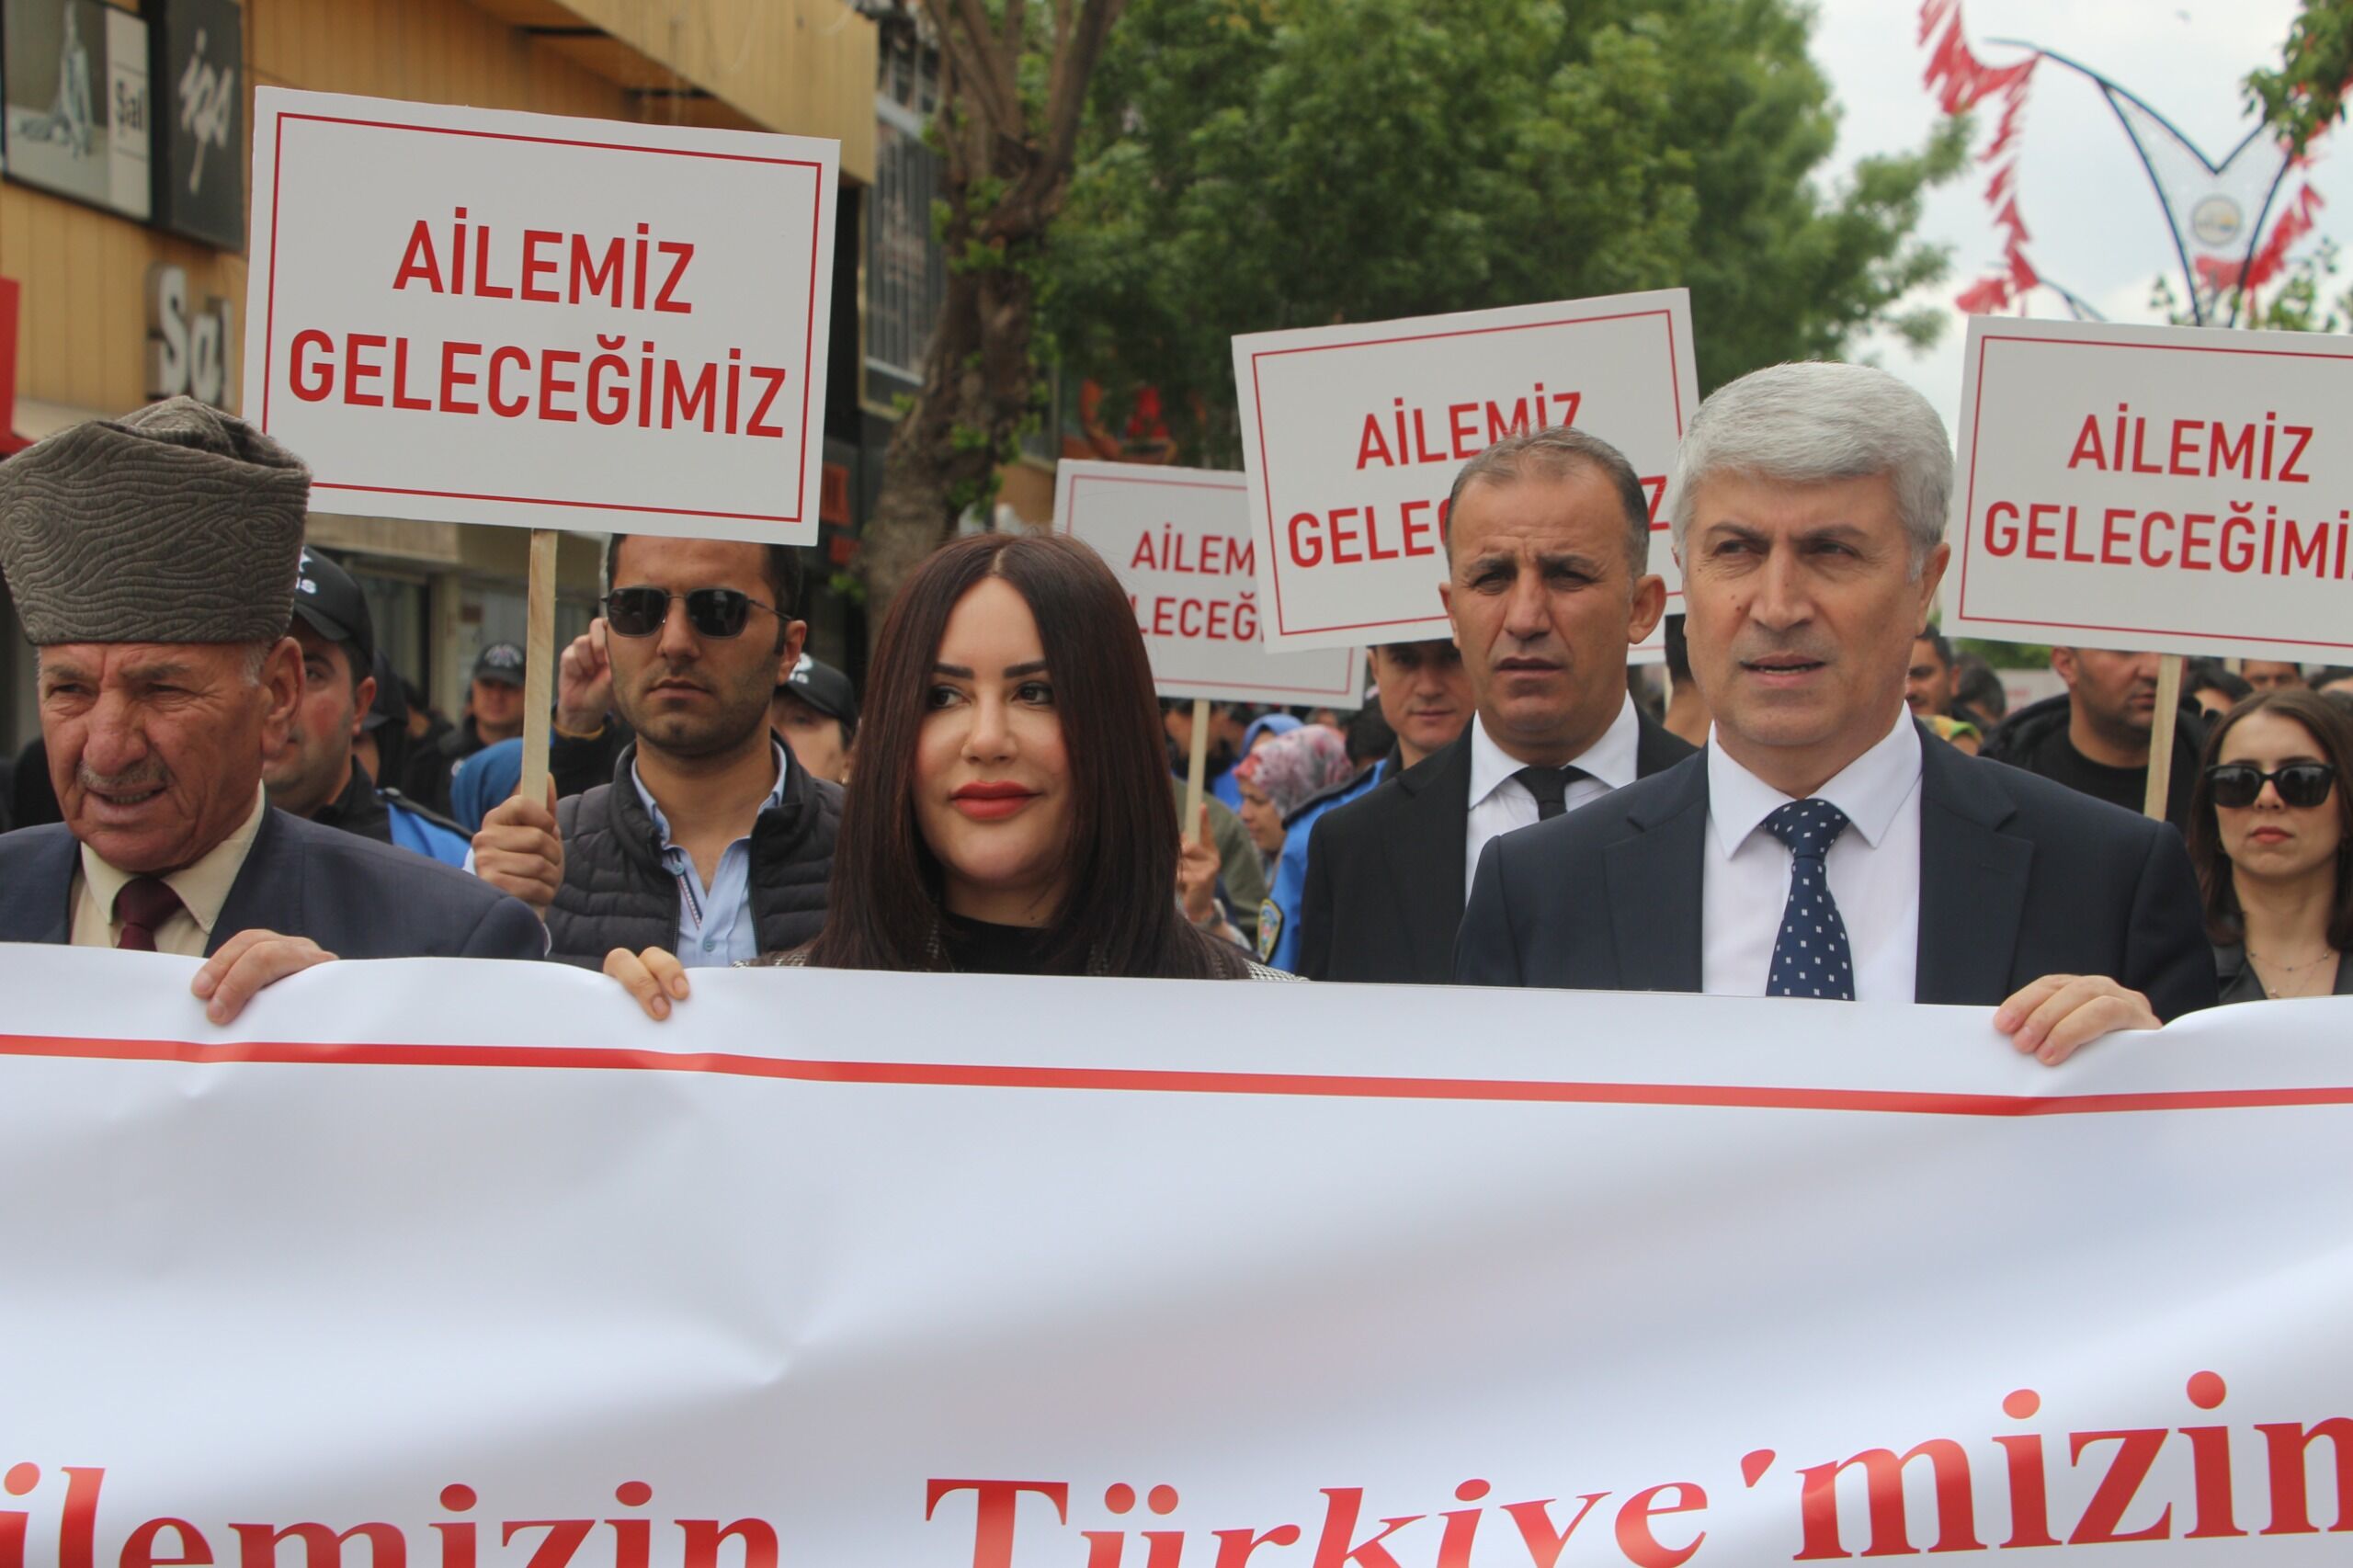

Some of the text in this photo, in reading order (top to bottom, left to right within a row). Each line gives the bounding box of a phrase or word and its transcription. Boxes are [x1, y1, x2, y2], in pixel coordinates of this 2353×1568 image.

[392, 206, 695, 314] AİLEMİZ
[290, 328, 786, 438] GELECEĞİMİZ
[2067, 402, 2313, 483] AİLEMİZ
[1131, 522, 1256, 577] AİLEM
[1984, 500, 2353, 580] GELECEĞİMİ
